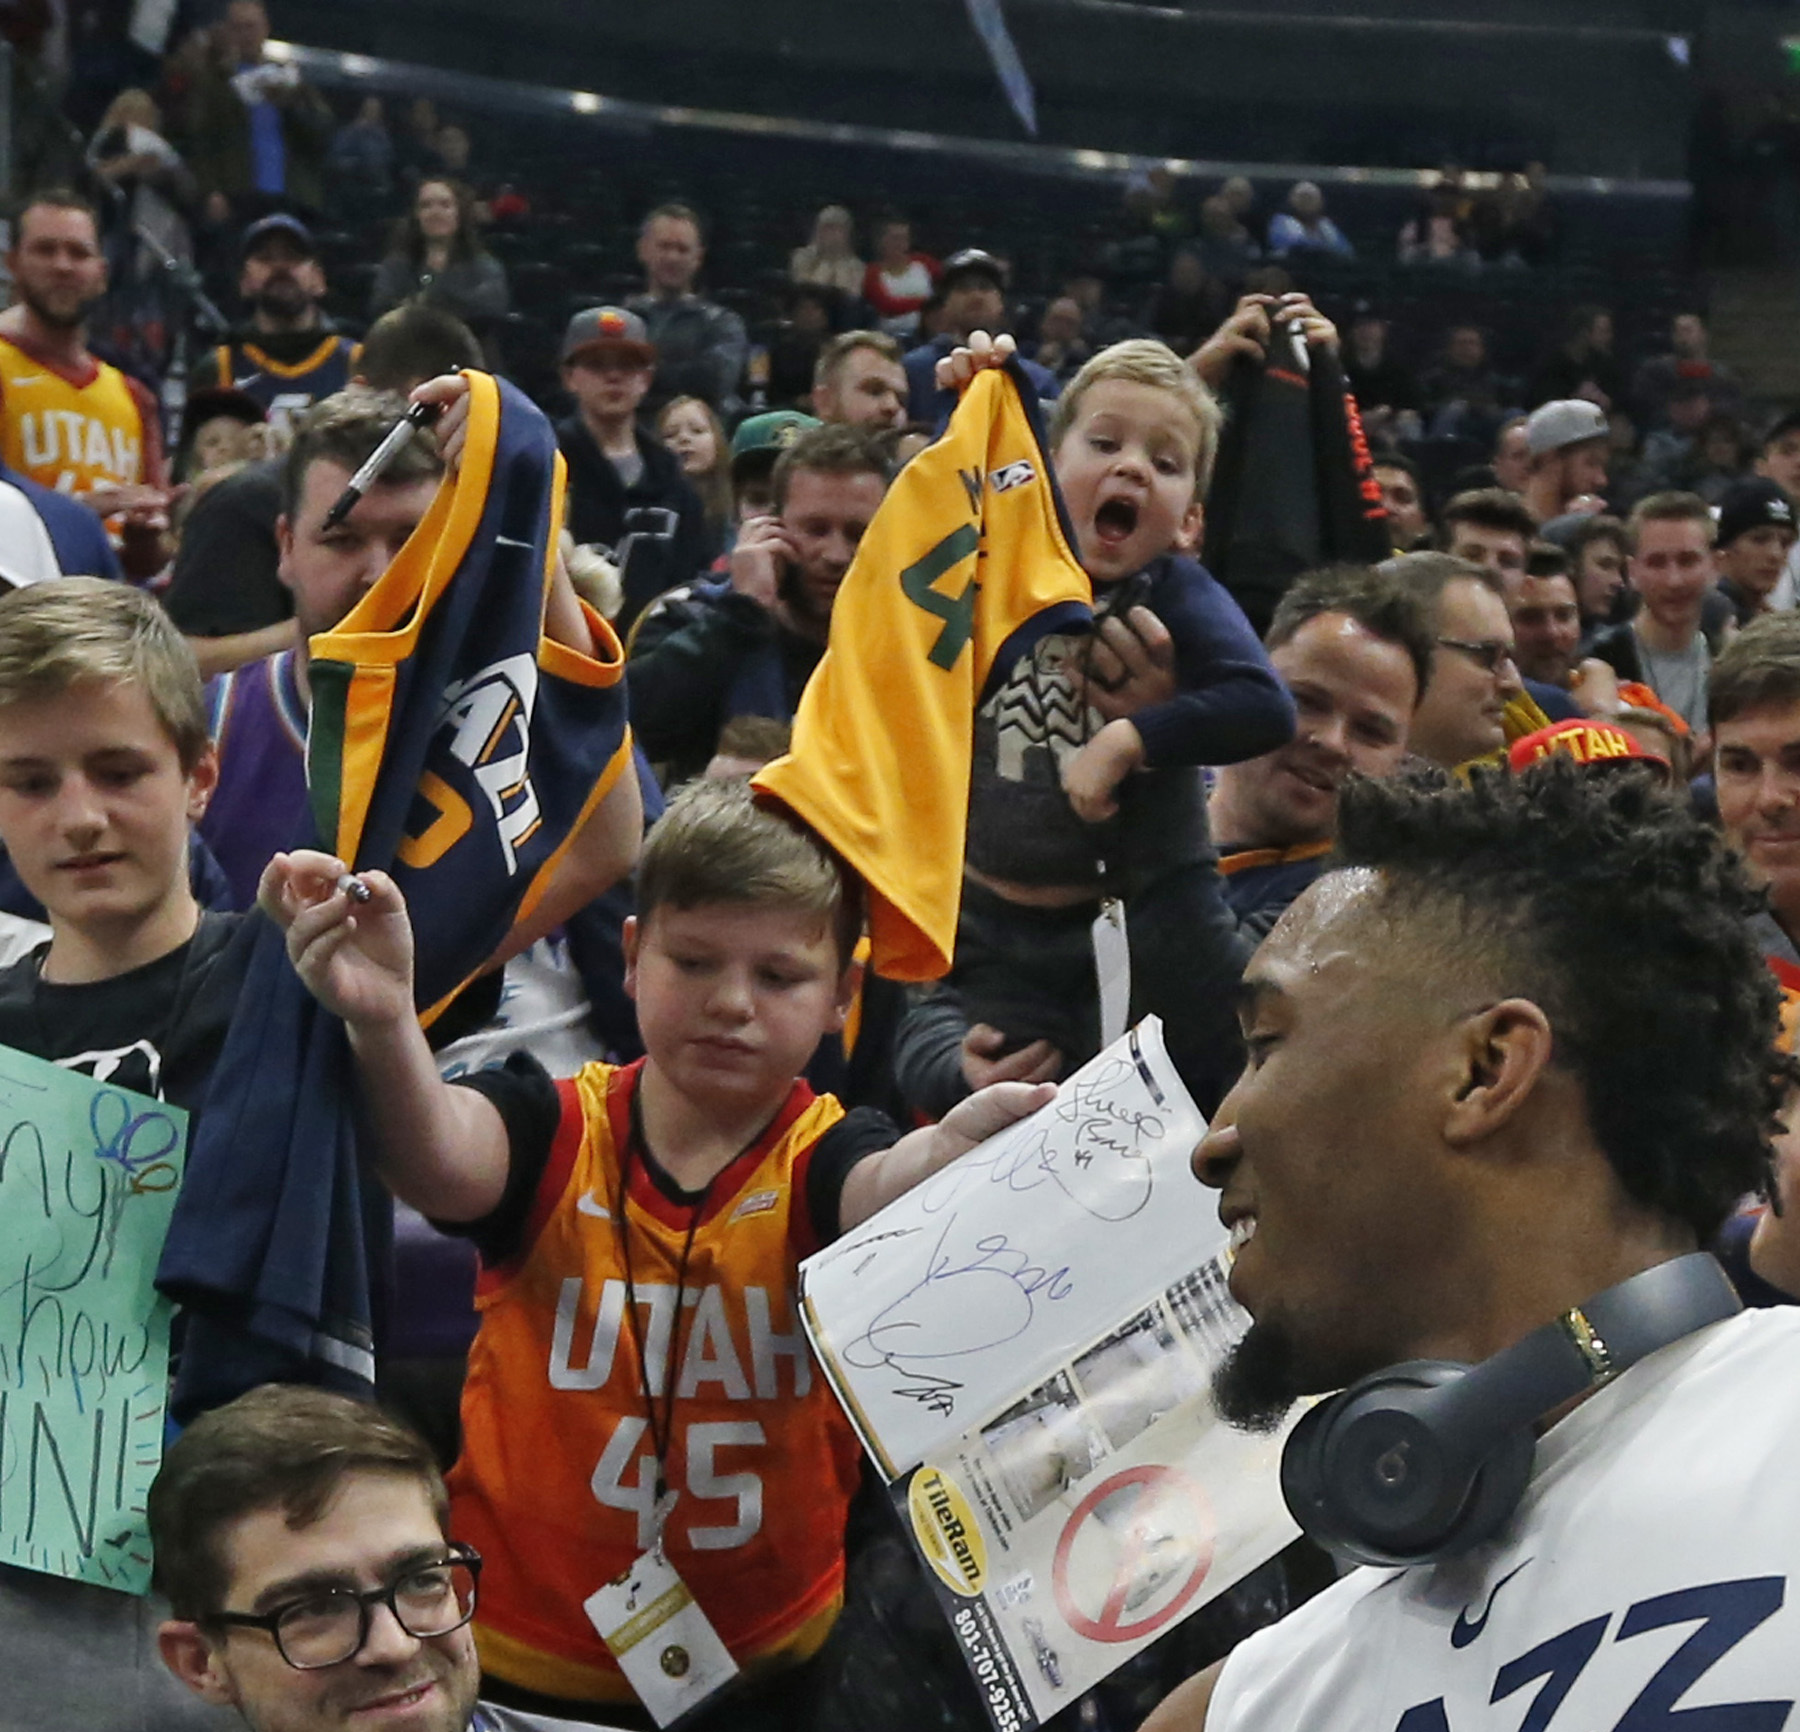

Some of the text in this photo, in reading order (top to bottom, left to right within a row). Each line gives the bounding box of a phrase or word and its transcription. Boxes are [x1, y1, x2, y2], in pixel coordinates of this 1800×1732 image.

[21, 408, 141, 485] UTAH
[15, 1253, 149, 1380] how
[547, 1277, 813, 1399] UTAH
[590, 1419, 766, 1551] 45
[922, 1472, 981, 1582] TileRam
